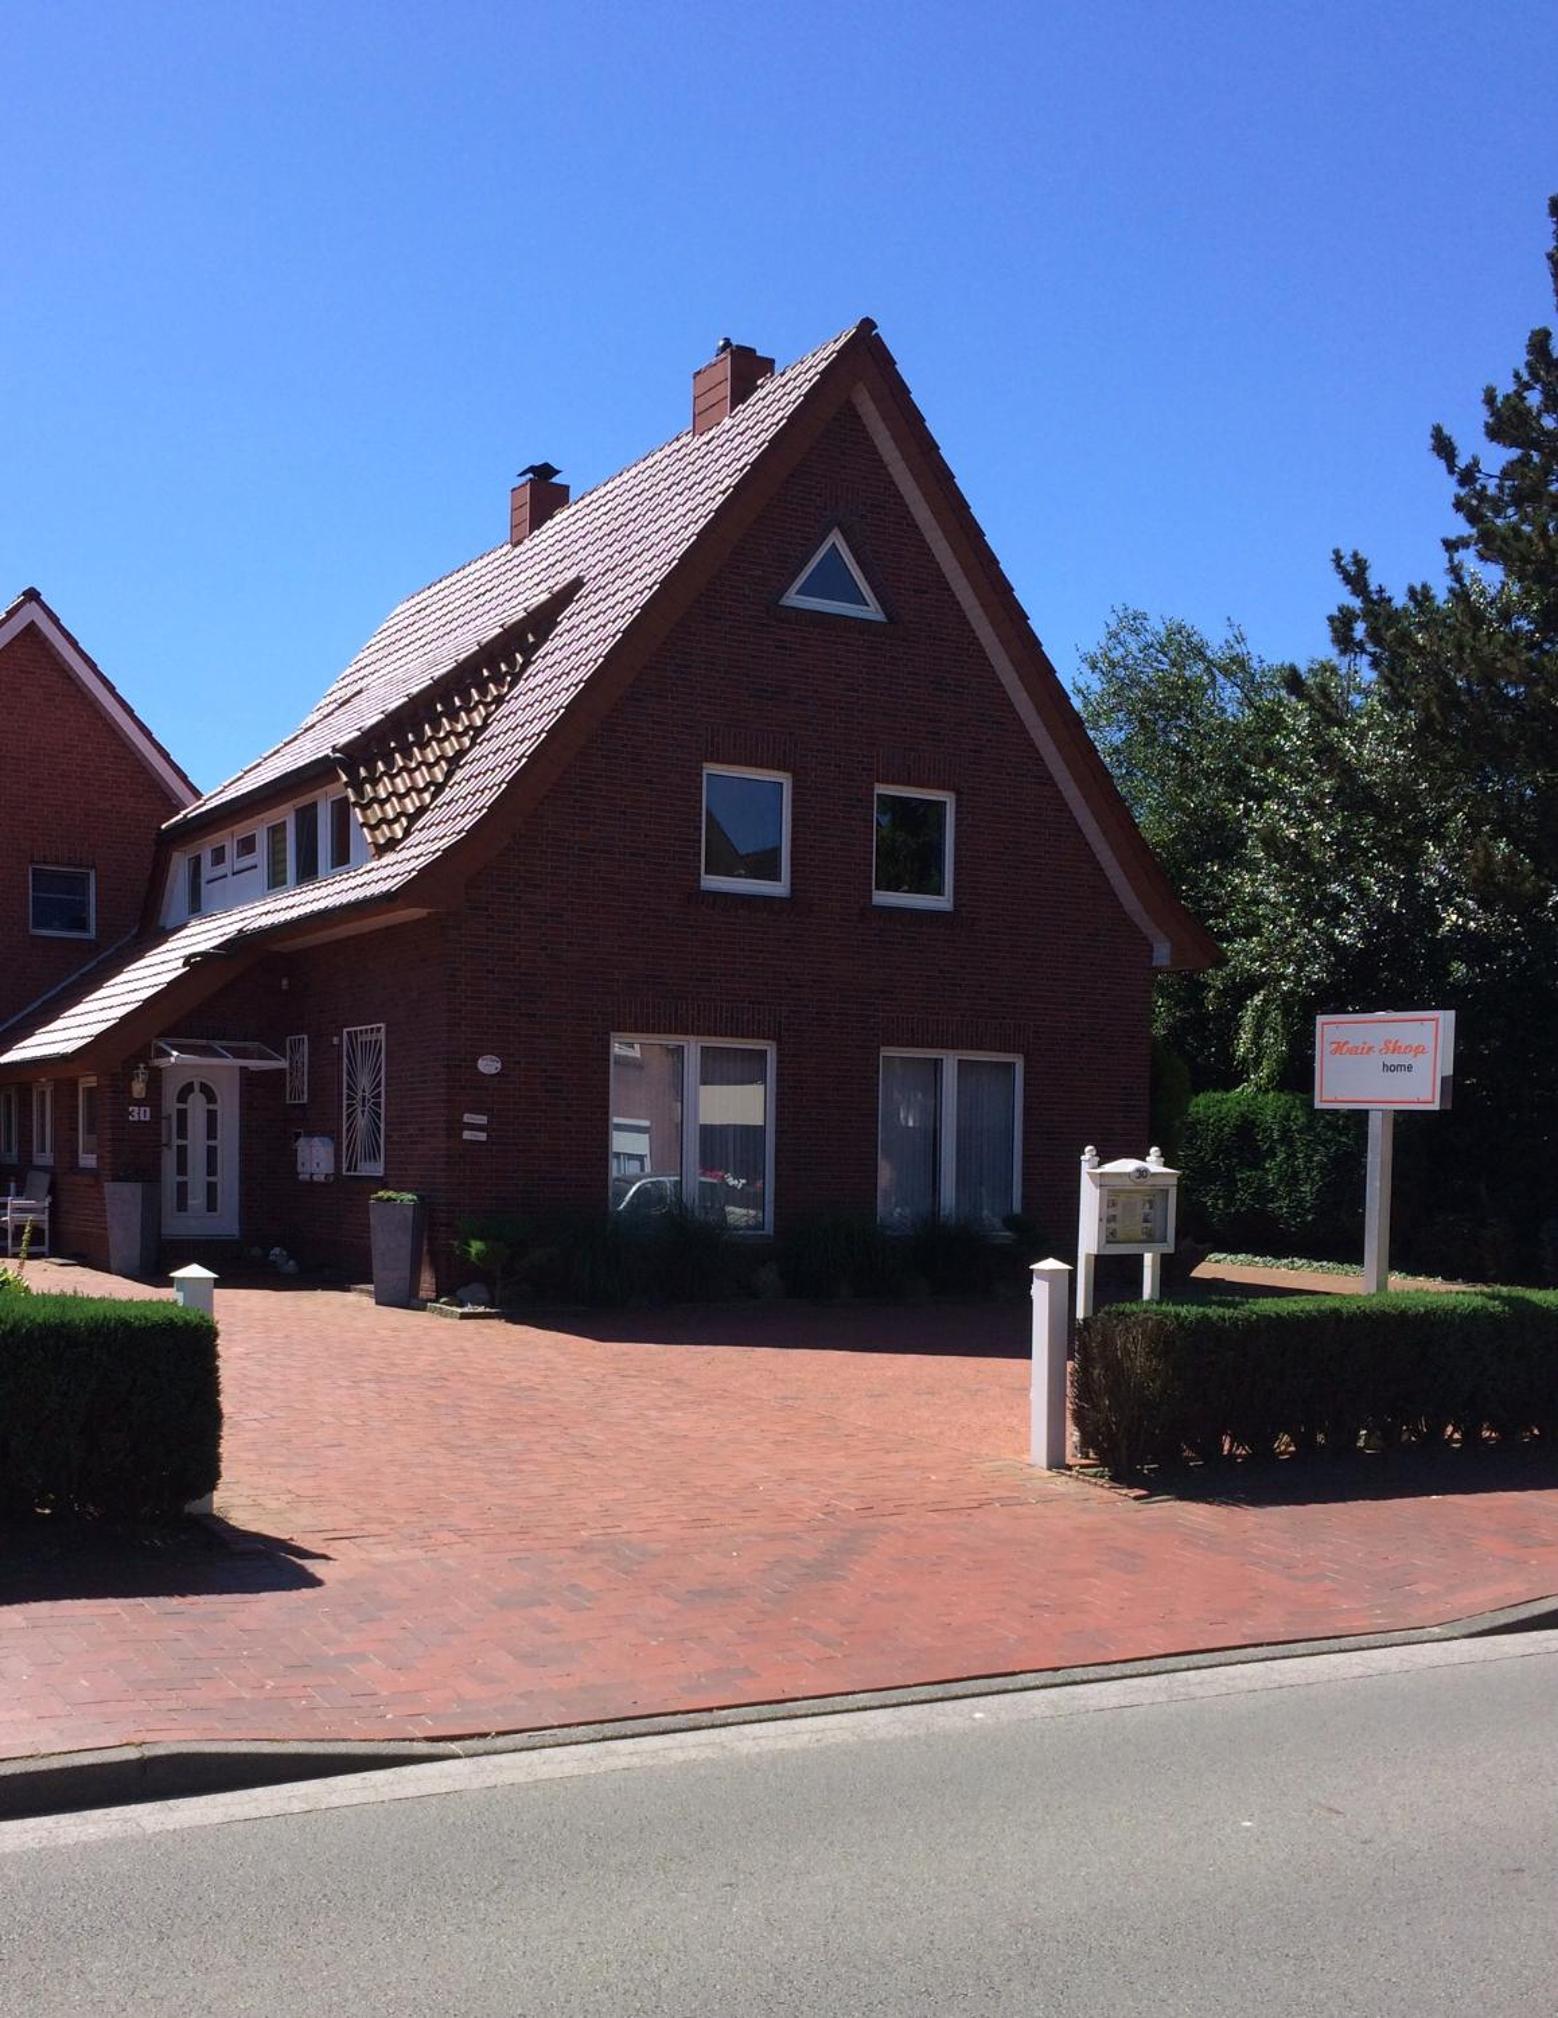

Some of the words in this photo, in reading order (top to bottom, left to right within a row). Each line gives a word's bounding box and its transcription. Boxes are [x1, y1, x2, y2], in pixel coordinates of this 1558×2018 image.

[1330, 1040, 1376, 1056] Hair
[1379, 1038, 1429, 1059] Shop
[1382, 1061, 1414, 1073] home
[128, 1106, 151, 1121] 30
